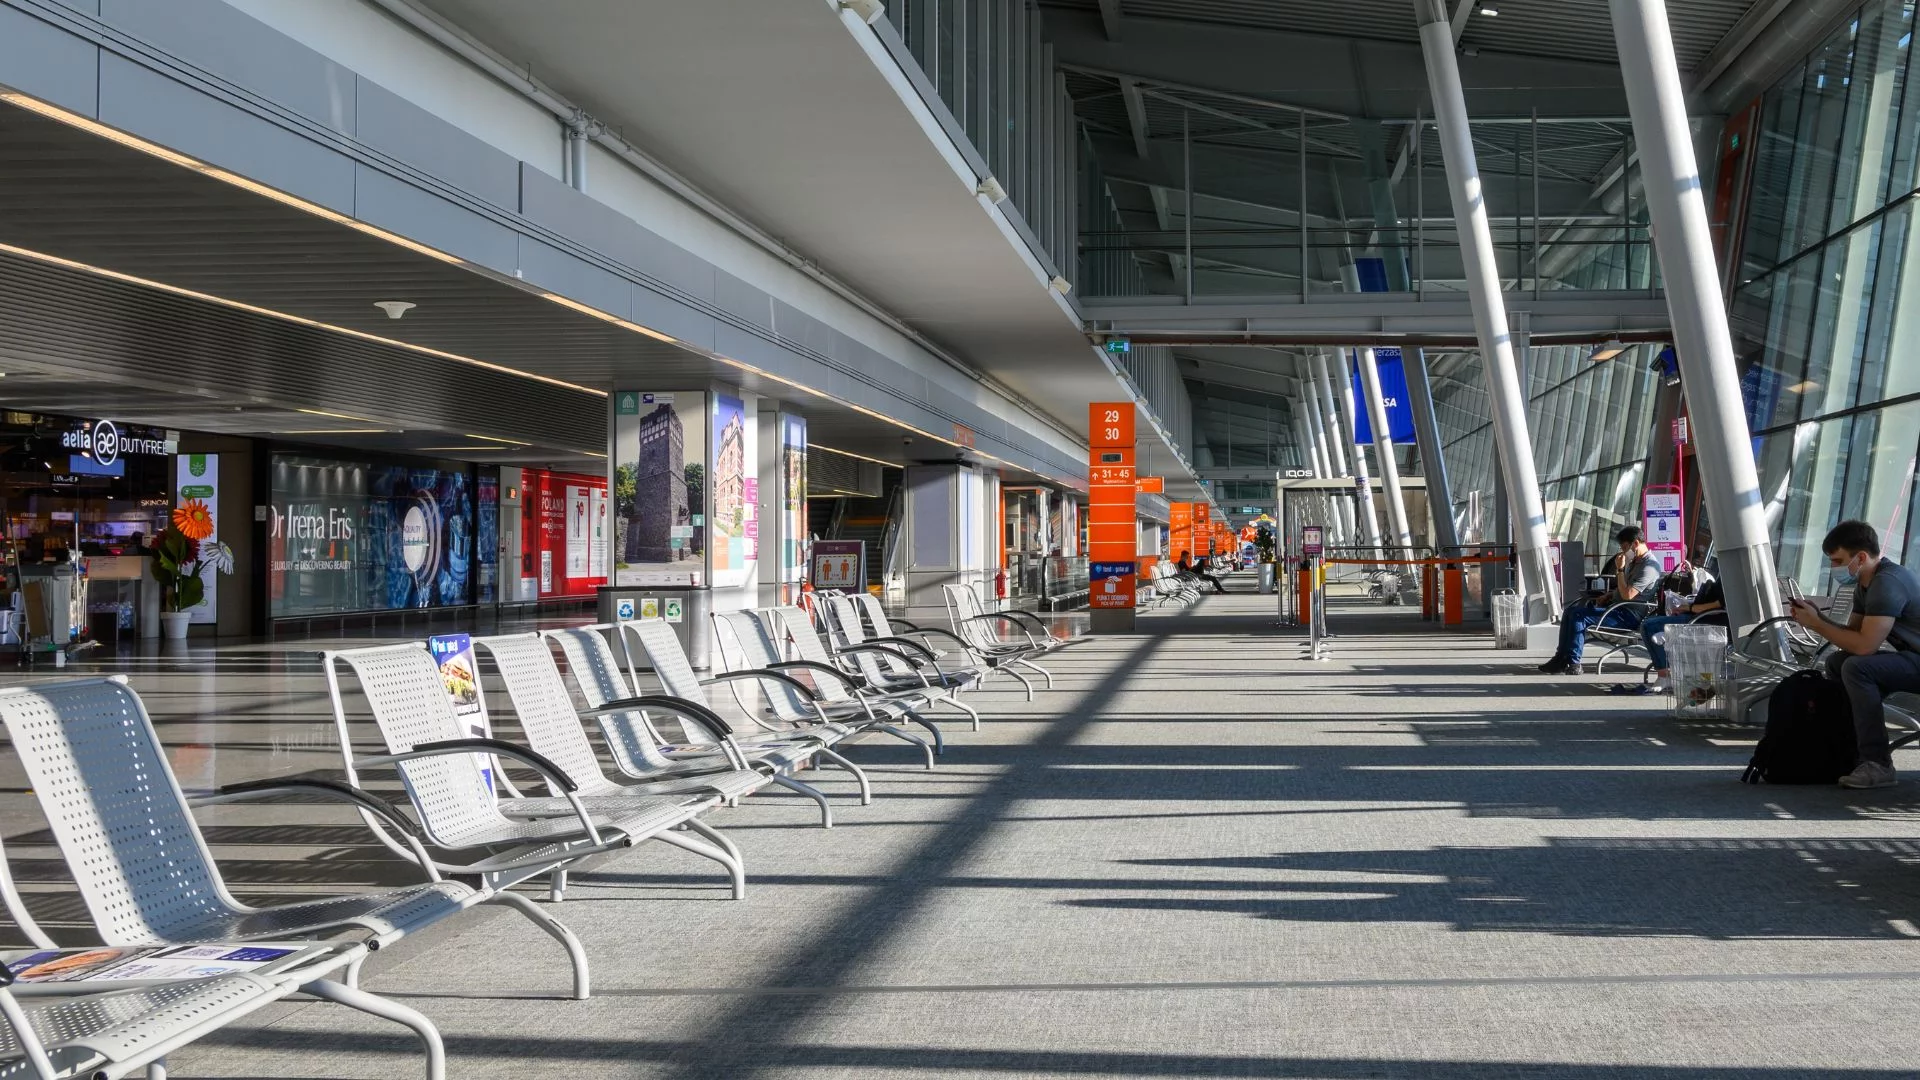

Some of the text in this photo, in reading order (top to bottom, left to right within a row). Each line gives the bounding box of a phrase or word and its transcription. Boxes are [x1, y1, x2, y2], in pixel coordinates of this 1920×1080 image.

[1383, 398, 1397, 407] SA
[1104, 410, 1119, 423] 29
[1105, 428, 1119, 440] 30
[62, 429, 91, 449] aelia
[120, 437, 168, 455] DUTYFREE
[1102, 469, 1111, 478] 31
[1119, 469, 1130, 478] 45
[1285, 470, 1313, 478] IQOS
[541, 497, 564, 511] POLAND
[287, 504, 325, 540] Irena
[329, 507, 352, 540] Eris
[274, 560, 294, 570] LUXURY
[300, 559, 333, 570] DISCOVERING
[334, 560, 352, 570] BEAUTY
